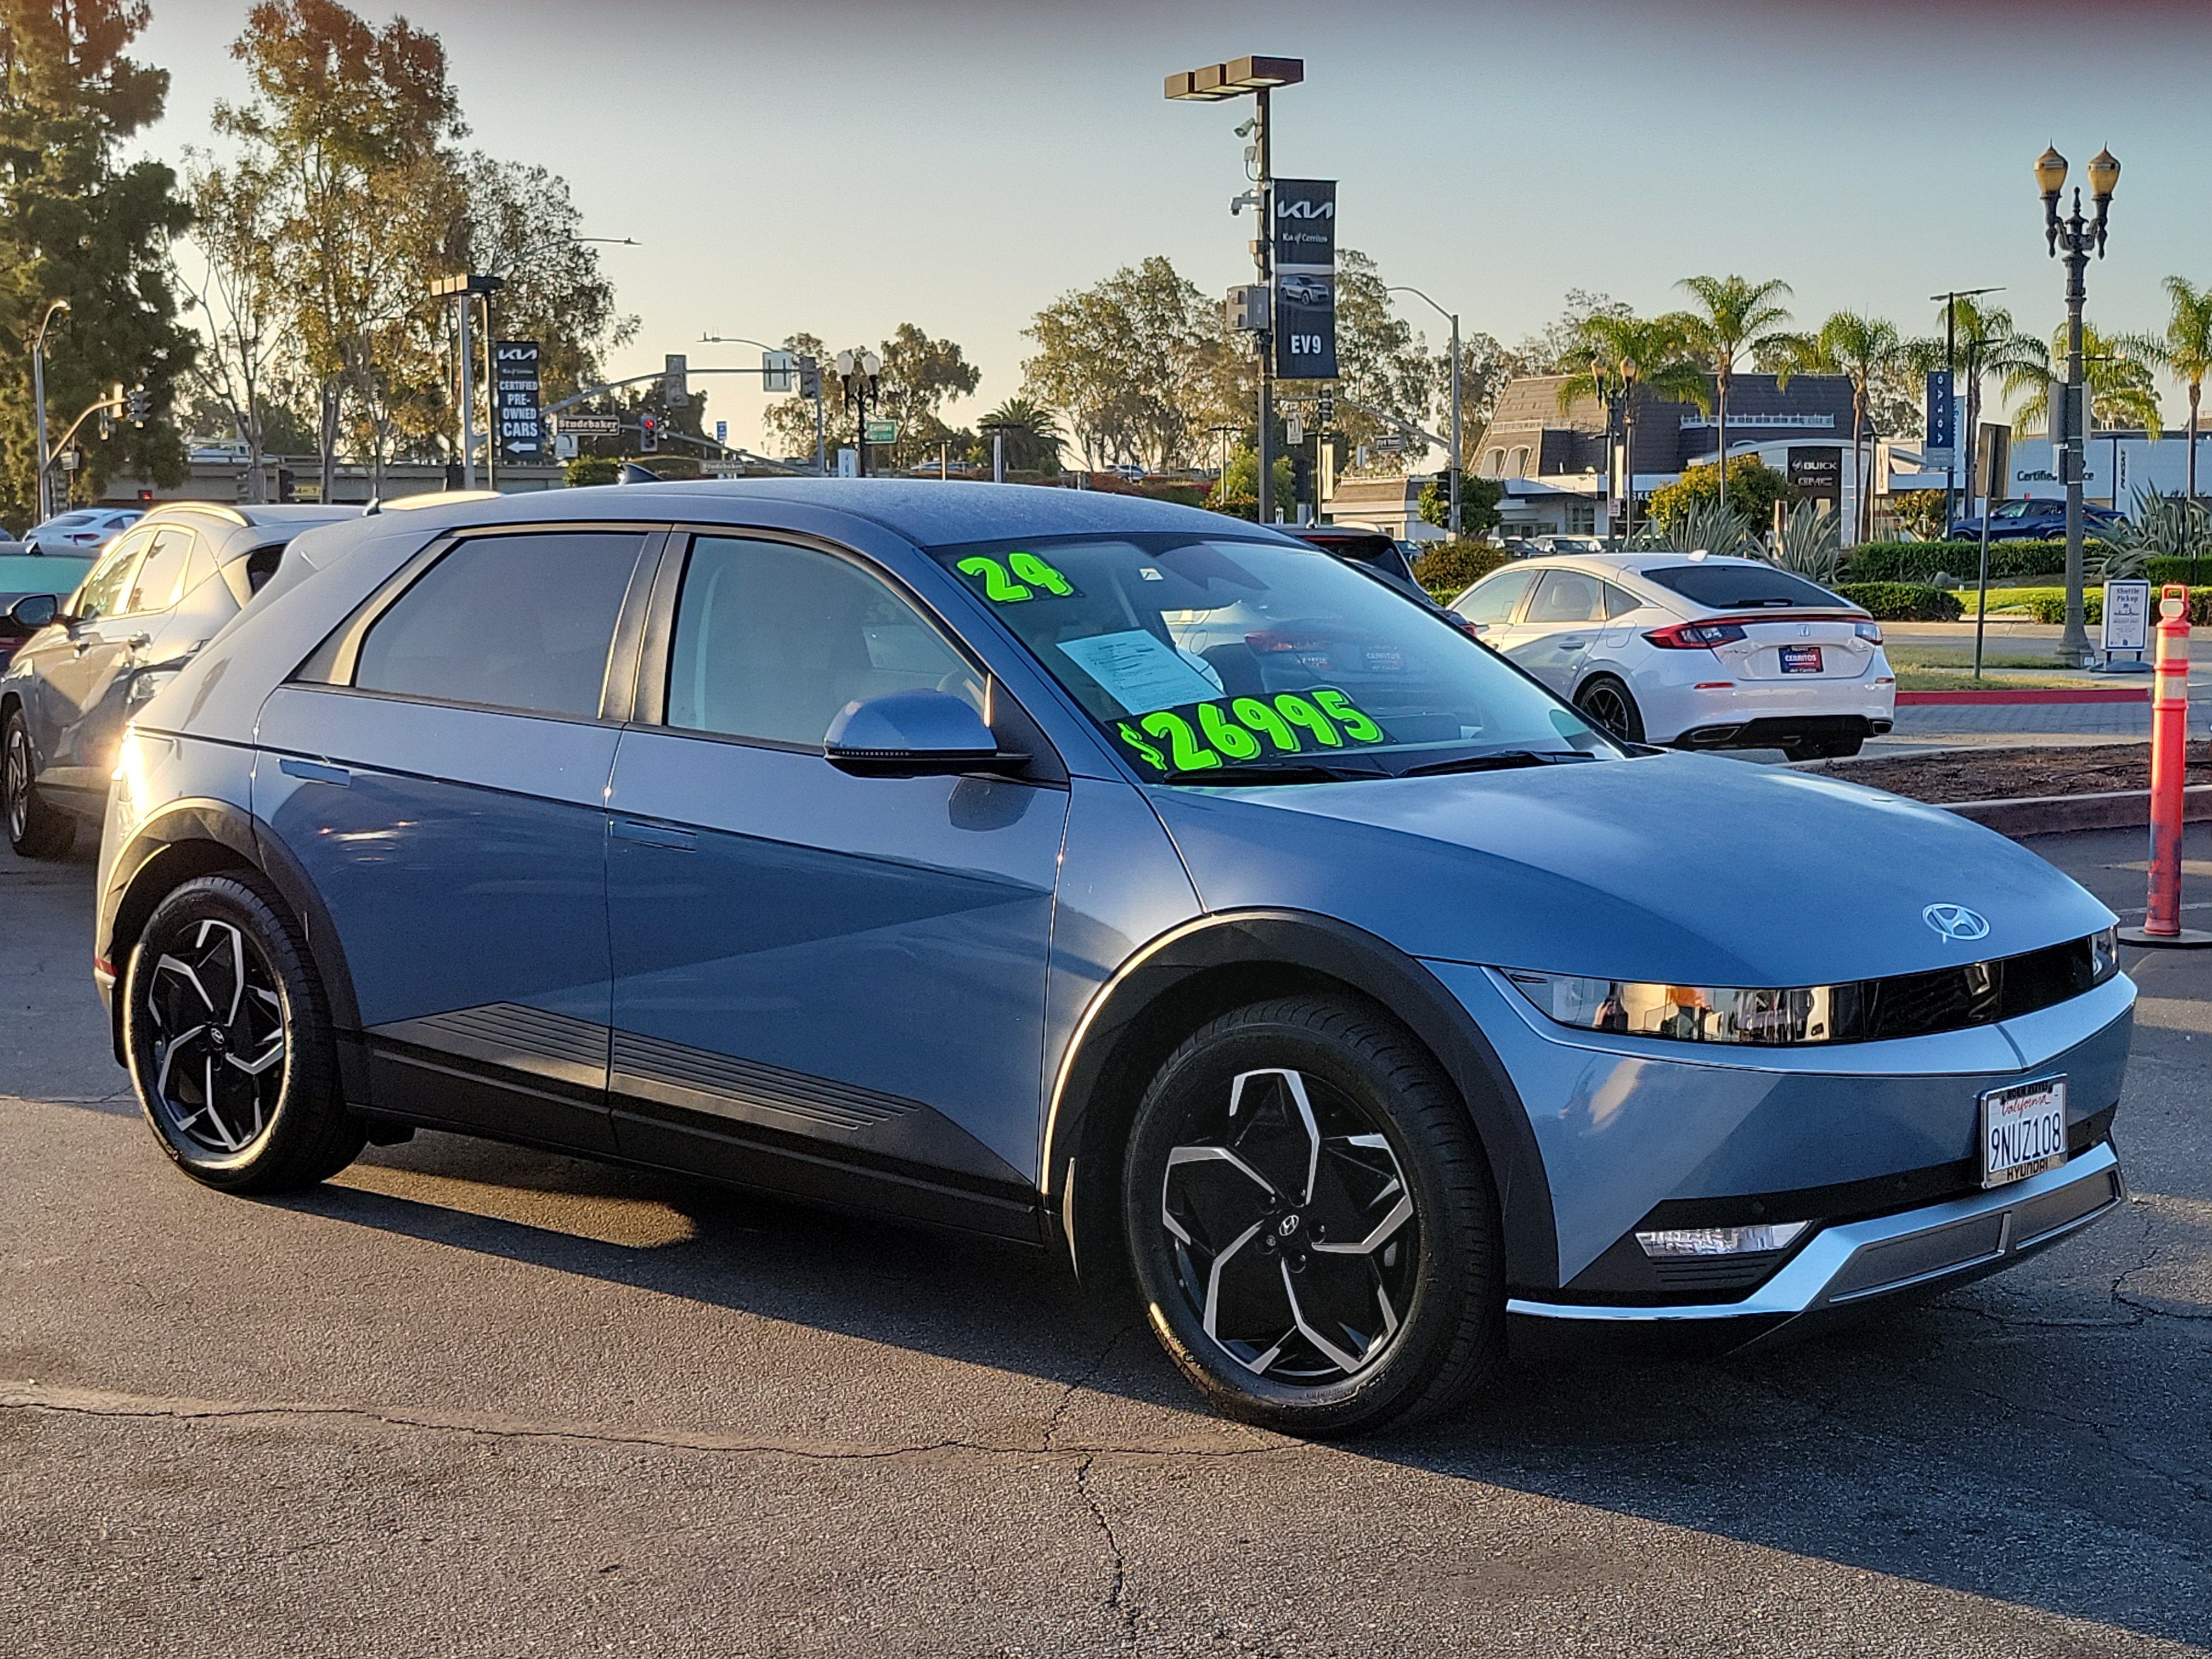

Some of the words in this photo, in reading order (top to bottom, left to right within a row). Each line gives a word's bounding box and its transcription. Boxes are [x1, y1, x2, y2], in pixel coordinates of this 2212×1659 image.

[1277, 200, 1333, 219] KIA
[1291, 335, 1321, 354] EV9
[499, 349, 538, 360] KIA
[500, 381, 538, 391] CERTIFIED
[507, 394, 531, 405] PRE-
[503, 408, 537, 420] OWNED
[503, 423, 538, 437] CARS
[1804, 461, 1837, 470] BUICK
[1798, 477, 1832, 487] GMC
[957, 552, 1074, 603] 24
[1785, 654, 1817, 662] CERRITOS
[1117, 690, 1384, 772] $26995
[2002, 1094, 2051, 1119] California
[1991, 1111, 2061, 1170] 9NUZ108
[2007, 1159, 2049, 1181] HYUNDAI
